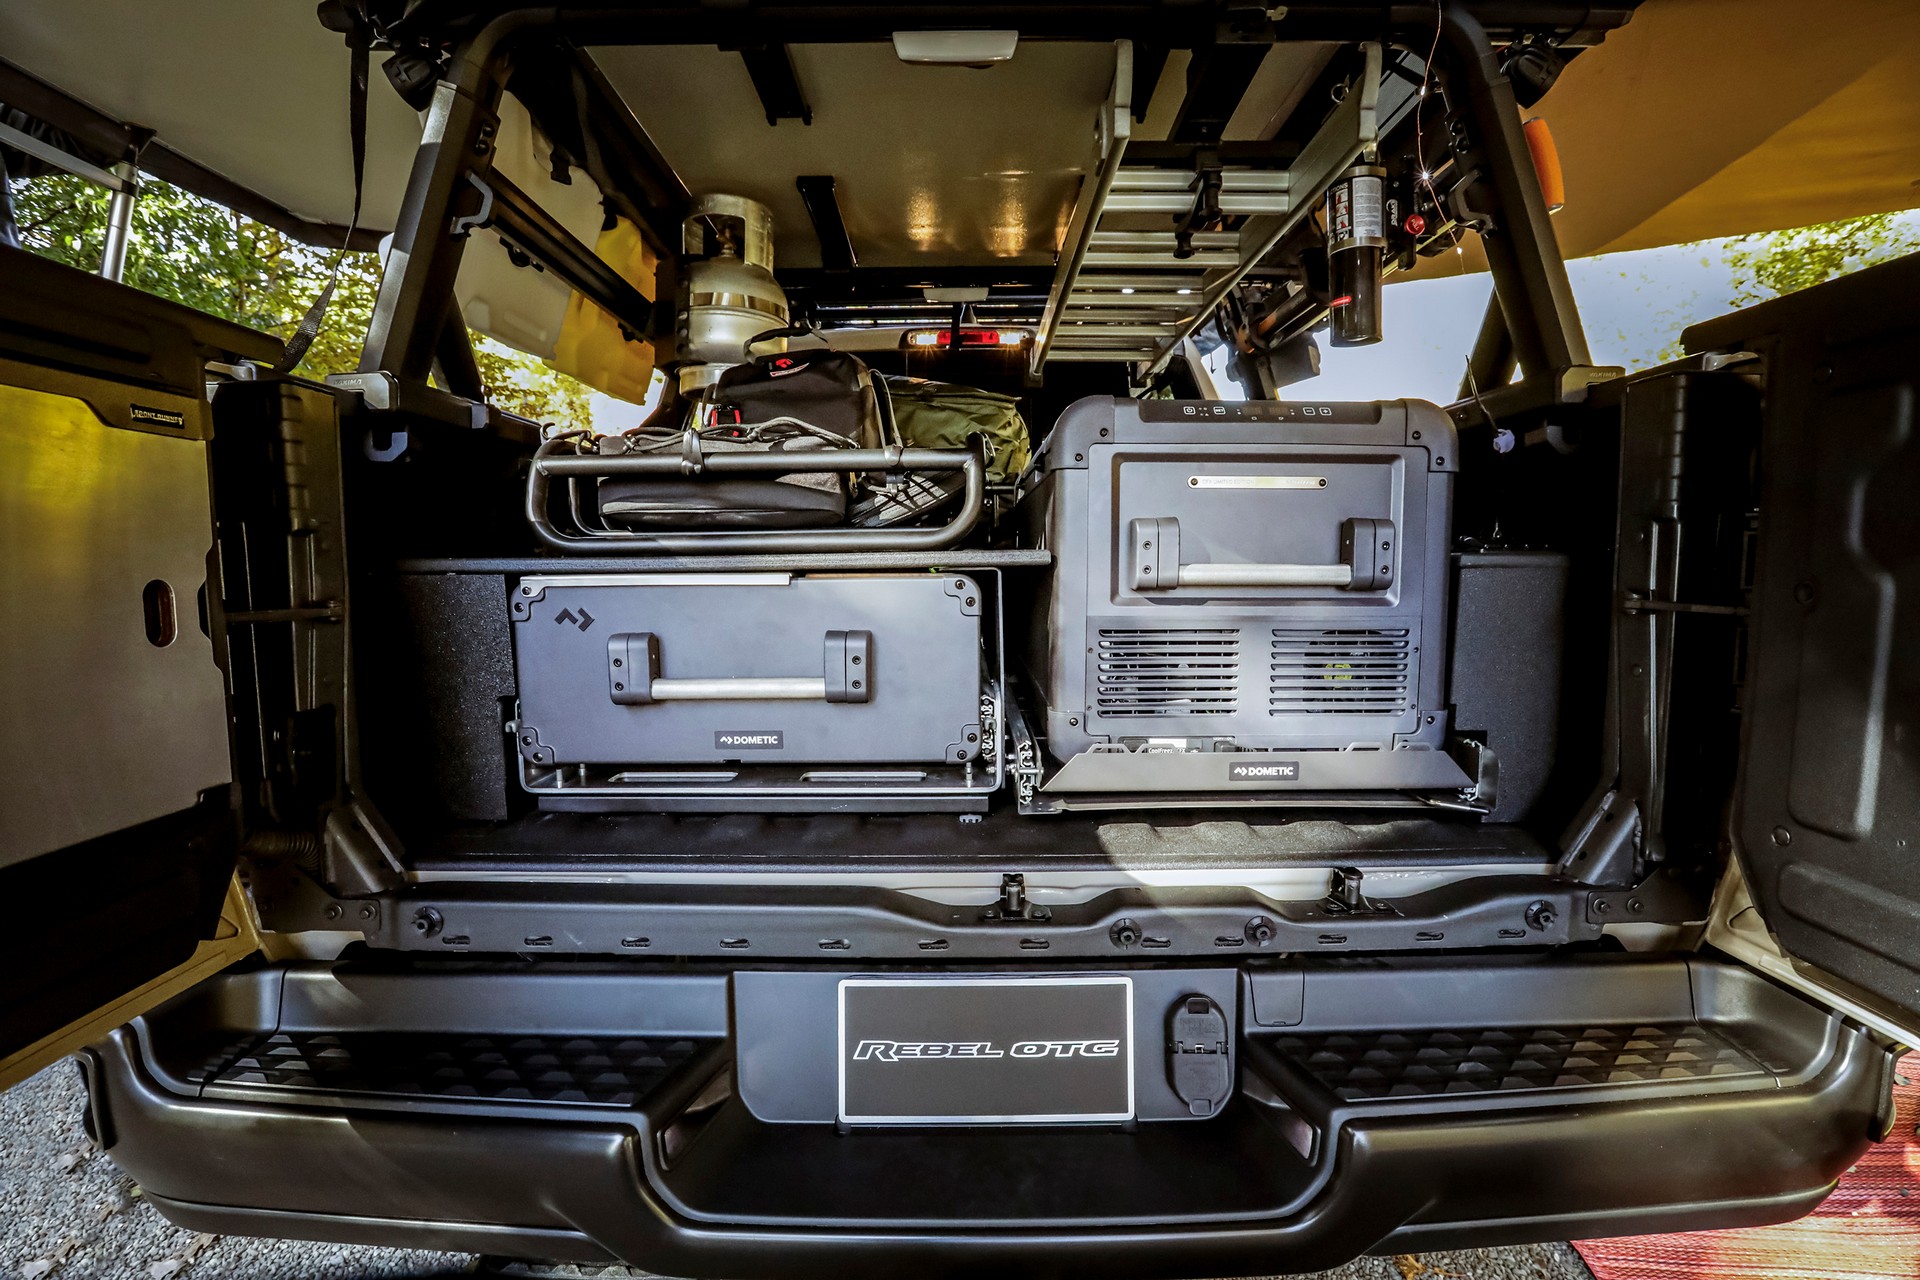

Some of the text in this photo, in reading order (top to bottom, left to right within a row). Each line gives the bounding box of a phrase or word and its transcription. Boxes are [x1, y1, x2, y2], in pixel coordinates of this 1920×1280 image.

[733, 735, 778, 744] DOMETIC
[1148, 746, 1174, 754] CoolFreez
[1247, 766, 1294, 776] DOMETIC
[853, 1039, 1120, 1062] REBEL OTG
